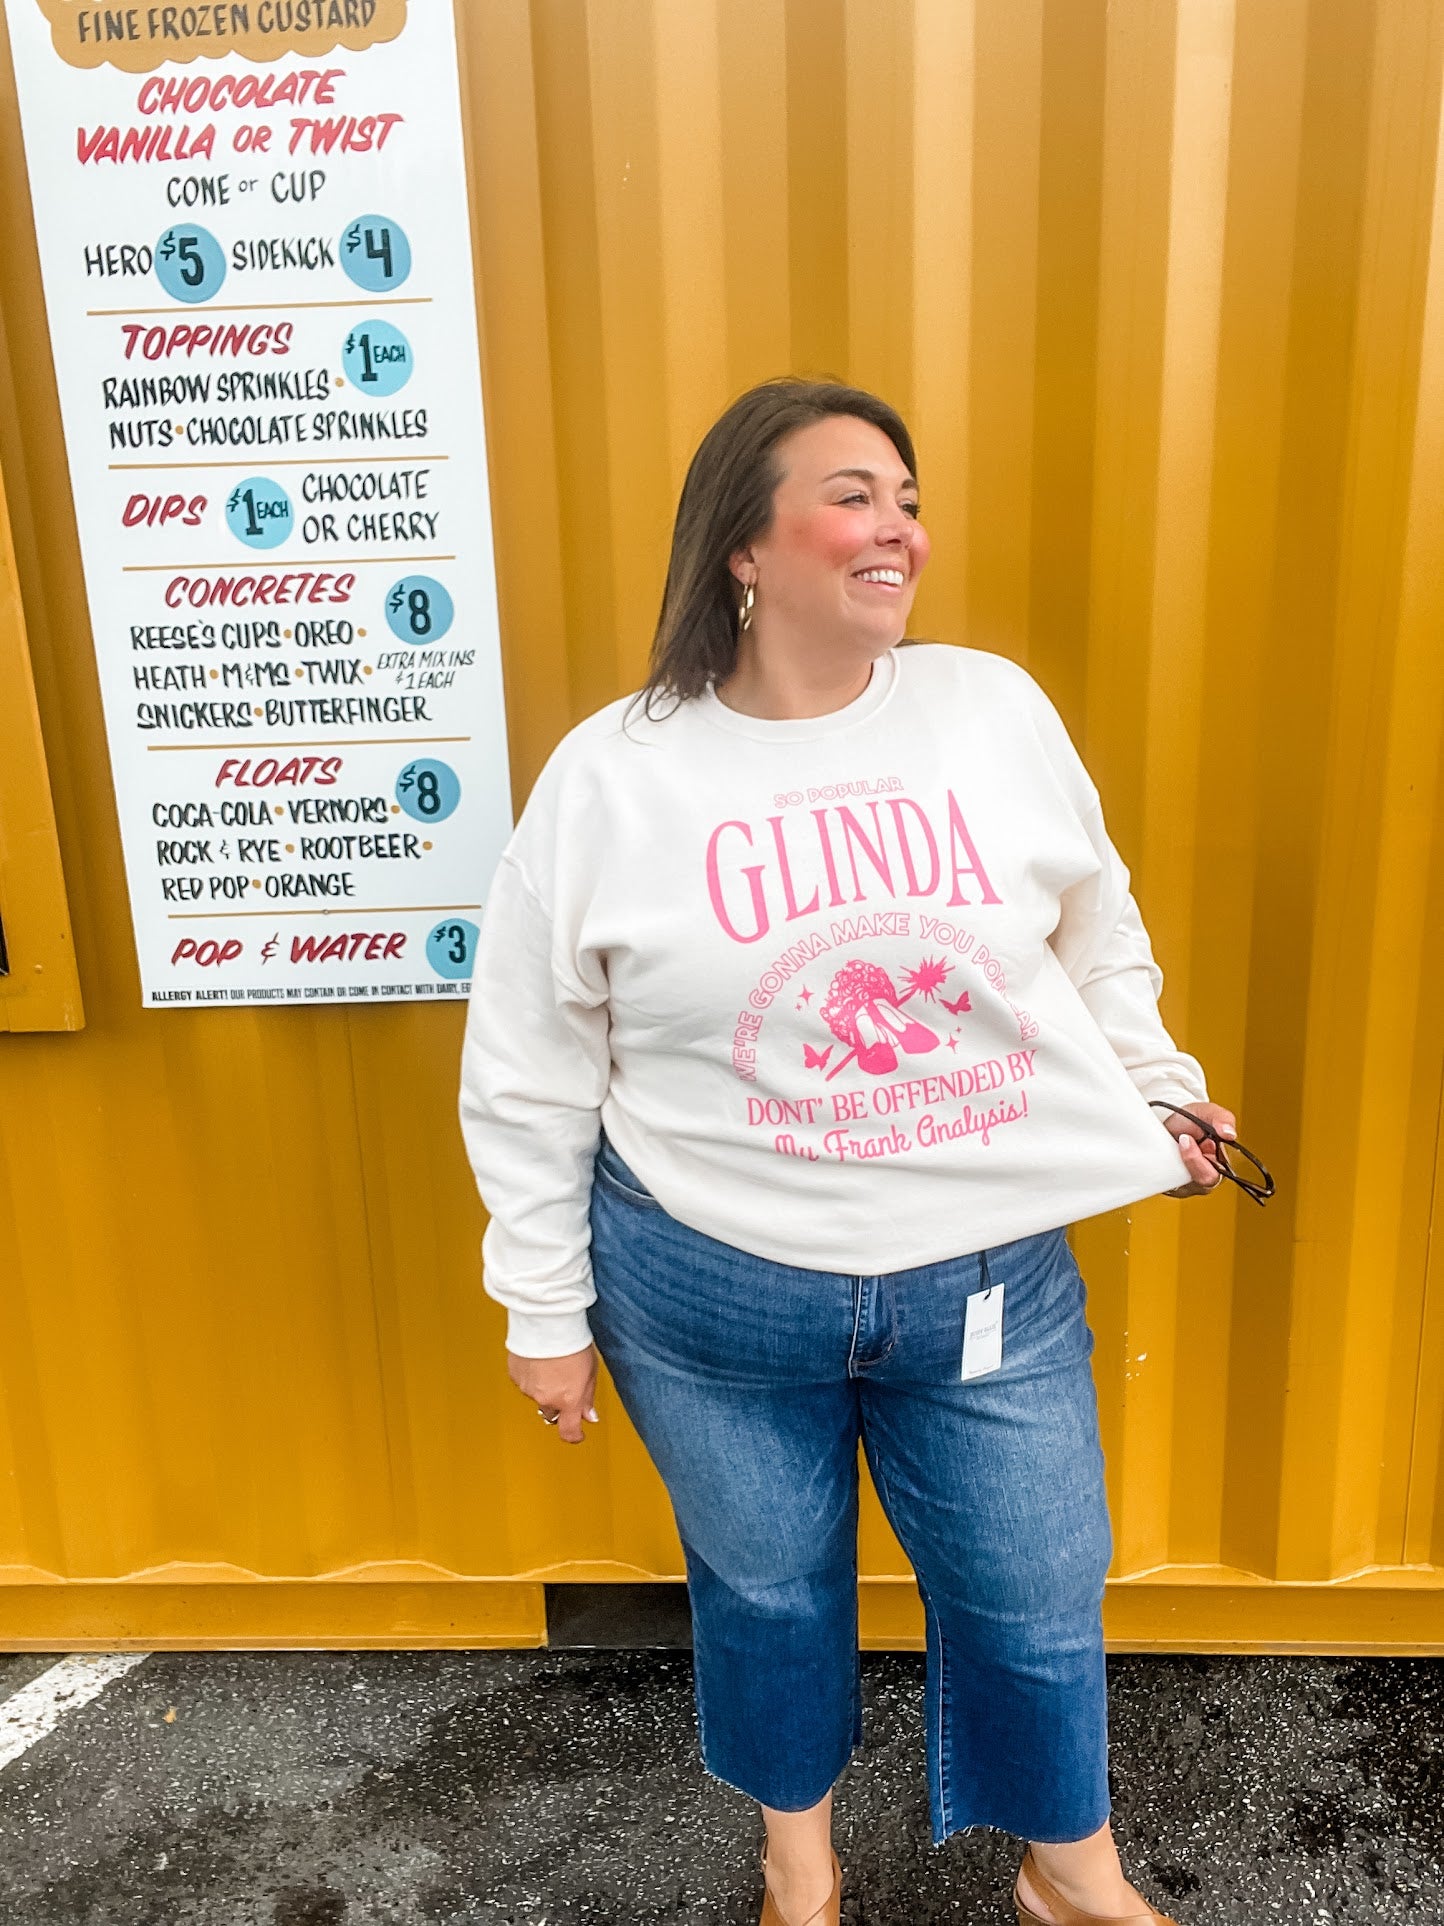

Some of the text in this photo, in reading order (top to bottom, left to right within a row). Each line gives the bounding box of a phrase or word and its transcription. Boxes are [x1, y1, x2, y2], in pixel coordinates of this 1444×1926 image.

[78, 0, 377, 43] FINE FROZEN CUSTARD
[137, 69, 346, 115] CHOCOLATE
[77, 113, 404, 166] VANILLA OR TWIST
[167, 170, 326, 208] CONE or CUP
[84, 225, 393, 287] HERO $5 SIDEKICK $4
[122, 322, 294, 361] TOPPINGS
[346, 333, 406, 382] $1 EACH
[102, 369, 330, 410] RAINBOW SPRINKLES
[109, 409, 428, 449] NUTS CHOCOLATE SPRINKLES
[303, 469, 430, 504] CHOCOLATE
[121, 494, 208, 528] DIPS
[227, 488, 289, 537] $1 EACH
[304, 511, 440, 544] OR CHERRY
[165, 573, 356, 608] CONCRETES
[389, 584, 430, 635] $8
[130, 619, 354, 651] REESE'S CUPS OREO
[133, 665, 206, 690] HEATH
[302, 659, 364, 685] TWIX
[378, 649, 475, 670] EXTRA MIX INS
[418, 671, 455, 689] EACH
[137, 696, 433, 730] SNICKERS BUTTERFINGER
[215, 757, 343, 788] FLOATS
[399, 765, 440, 815] $8
[774, 776, 904, 809] SO POPULAR
[153, 797, 389, 828] COCA-COLA VERNORS
[157, 839, 213, 866] ROCK
[238, 838, 282, 864] RYE
[706, 788, 1004, 944] GLINDA
[162, 872, 356, 902] RED POP ORANGE
[171, 938, 244, 967] POP
[290, 933, 408, 963] WATER
[434, 925, 467, 964] $3
[749, 934, 831, 1010] GONNA
[832, 912, 911, 946] MAKE
[919, 915, 976, 955] YOU
[152, 990, 192, 1001] ALLERGY
[196, 989, 228, 1000] ALERT!
[231, 989, 244, 1000] OUR
[247, 988, 285, 999] PRODUCTS
[287, 987, 301, 999] MAY
[304, 987, 335, 998] CONTAIN
[337, 986, 347, 997] OR
[350, 986, 369, 997] COME
[381, 984, 413, 996] CONTACT
[415, 984, 434, 995] WITH
[747, 1048, 1038, 1126] DONT' BE OFFENDED BY
[823, 1124, 912, 1162] Frank
[916, 1090, 1029, 1147] Analysis!
